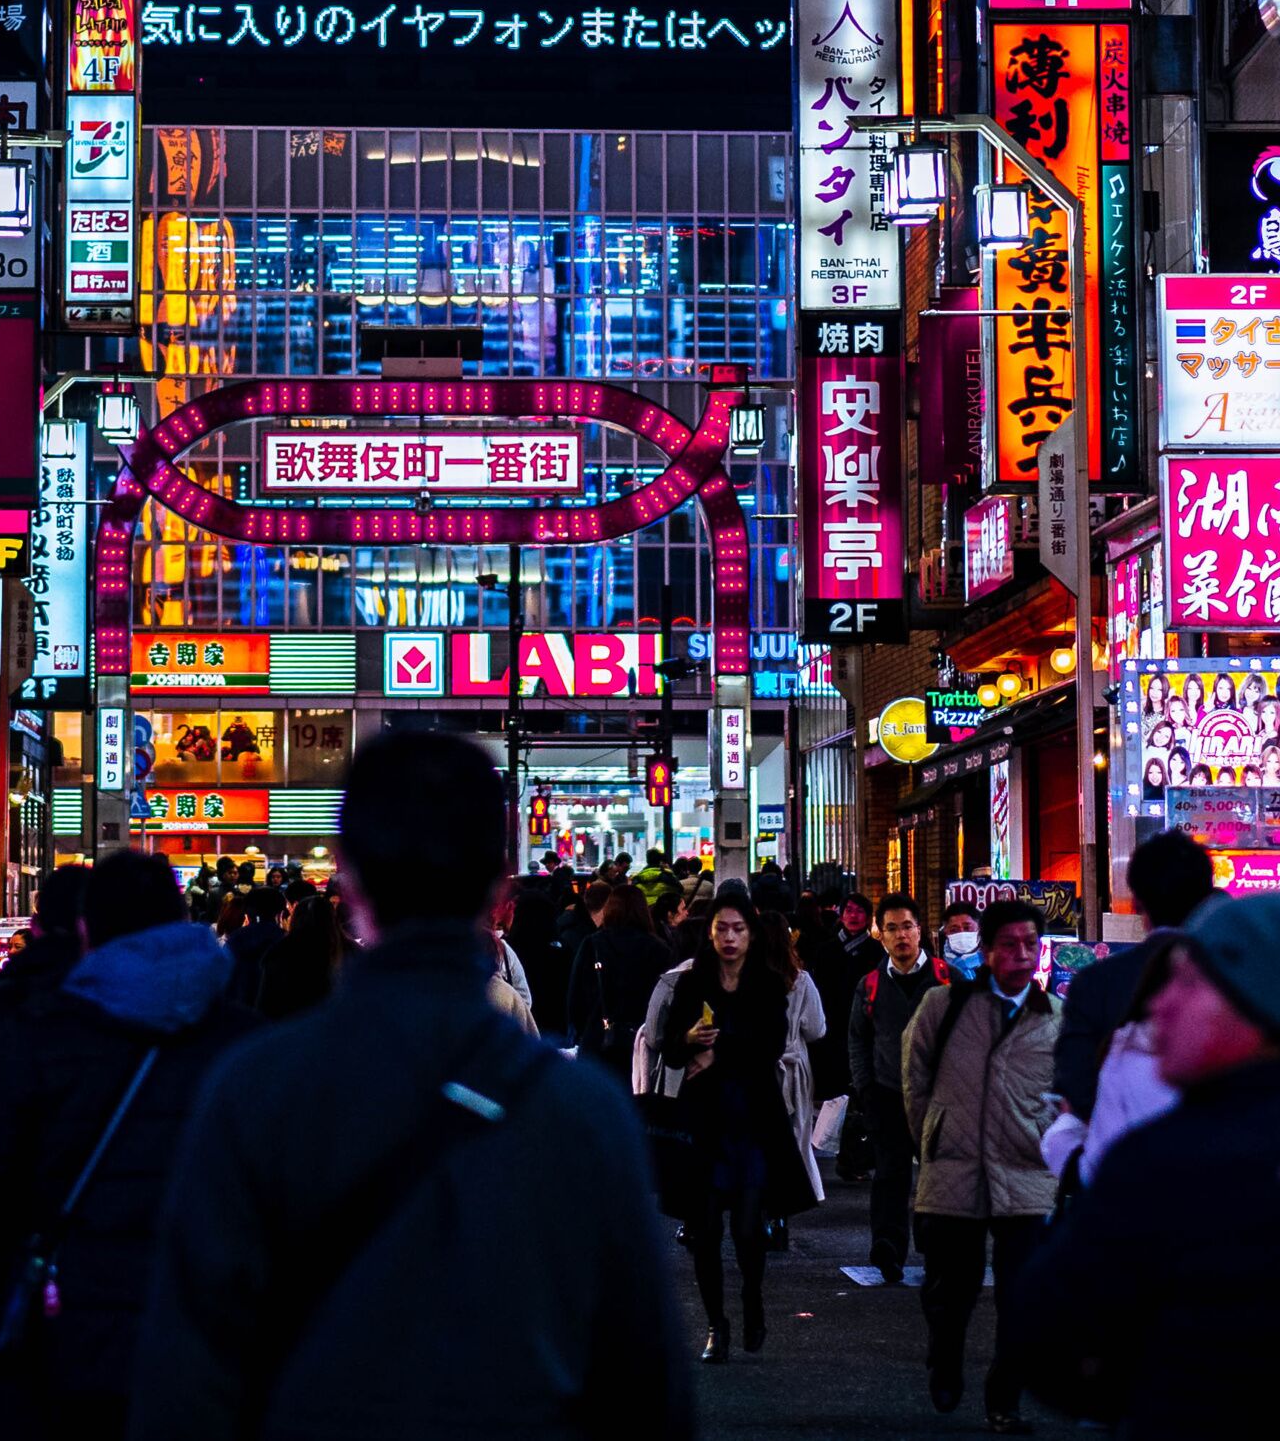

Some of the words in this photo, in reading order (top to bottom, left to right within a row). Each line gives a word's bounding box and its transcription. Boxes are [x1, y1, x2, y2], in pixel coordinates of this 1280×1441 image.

[83, 57, 119, 83] 4F
[1103, 39, 1130, 146] 炭火串焼
[811, 77, 860, 246] バンタイ
[73, 211, 127, 232] たばこ
[86, 242, 112, 261] 酒
[819, 258, 881, 268] BAN-THAI
[810, 268, 889, 280] RESTAURANT
[832, 285, 869, 305] 3F
[1230, 285, 1266, 305] 2F
[819, 321, 886, 355] 焼肉
[966, 348, 982, 456] ANRAKUTEI
[275, 441, 570, 485] 歌舞伎町一番街
[822, 374, 885, 582] 安楽亭
[1049, 453, 1066, 555] 劇場通り一番街
[829, 602, 878, 634] 2F
[452, 633, 663, 696] LABI
[22, 678, 57, 698] 2F
[105, 715, 119, 783] 劇場通り
[726, 715, 740, 782] 劇場通り
